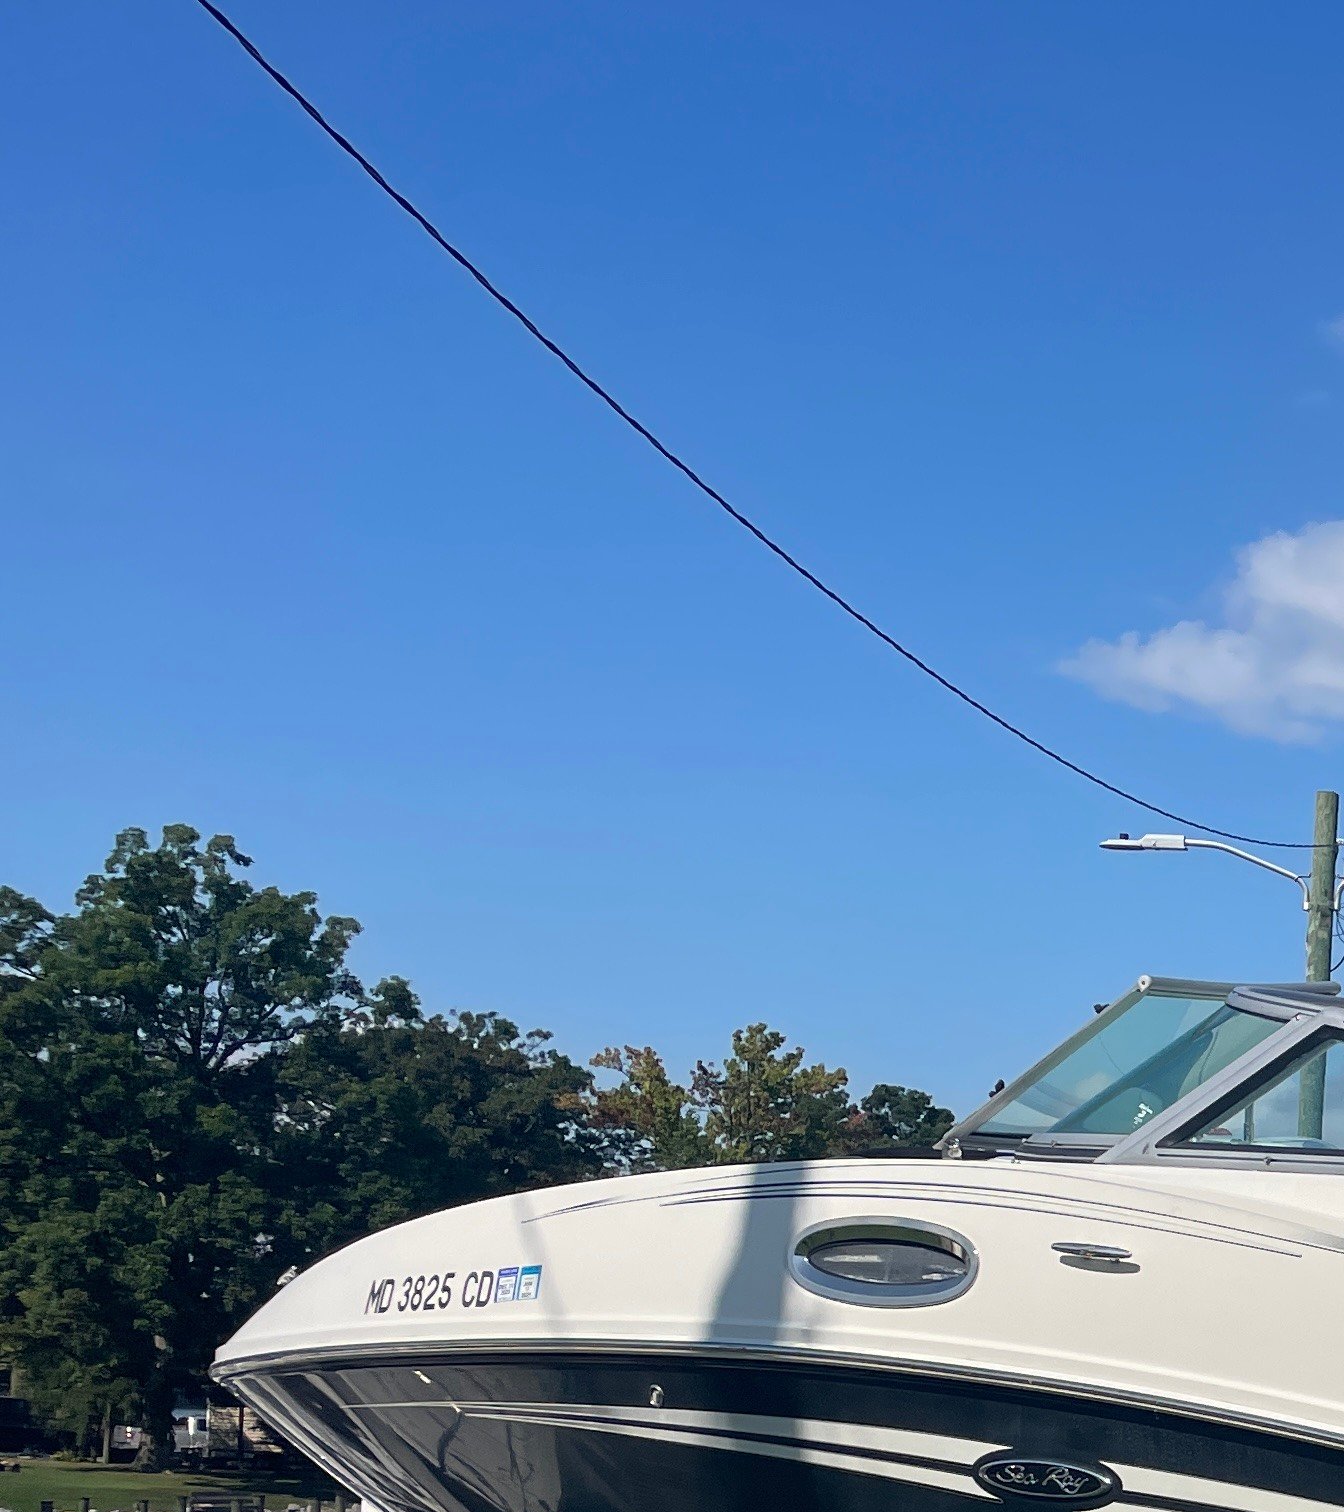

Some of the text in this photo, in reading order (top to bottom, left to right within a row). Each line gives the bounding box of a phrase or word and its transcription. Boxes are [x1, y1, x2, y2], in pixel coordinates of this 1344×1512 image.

[364, 1278, 395, 1315] MD
[397, 1271, 457, 1312] 3825
[461, 1270, 495, 1308] CD
[996, 1464, 1089, 1495] Sea Ray
